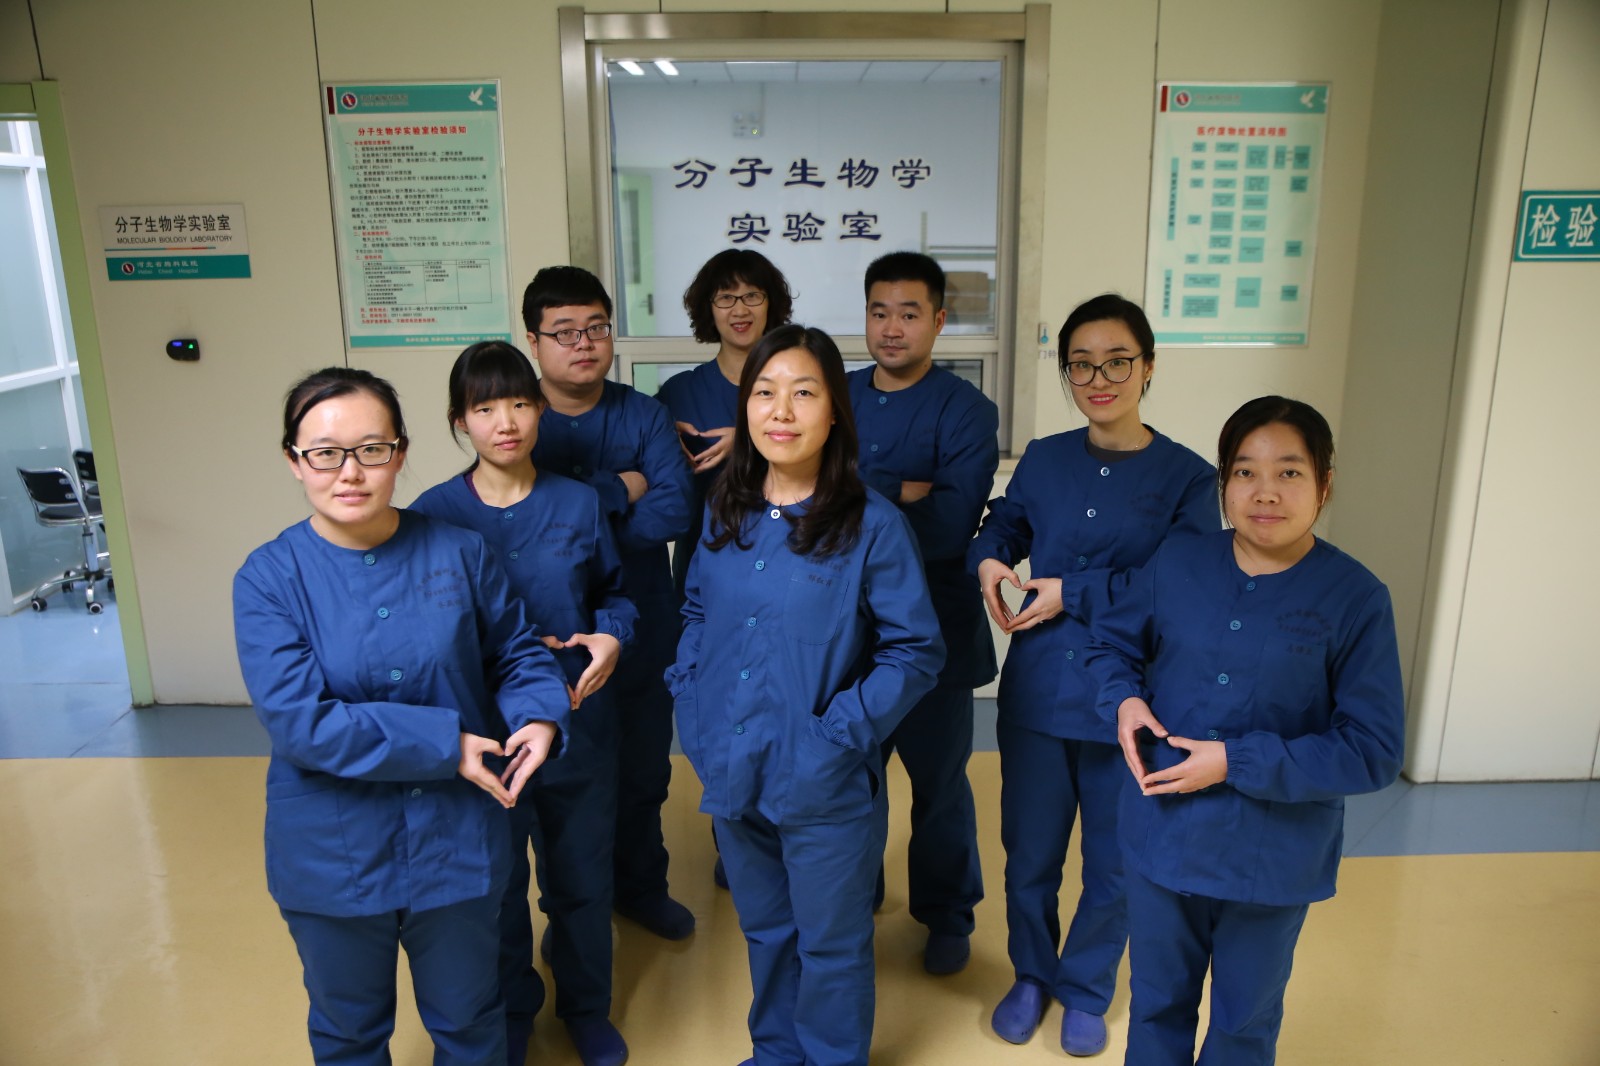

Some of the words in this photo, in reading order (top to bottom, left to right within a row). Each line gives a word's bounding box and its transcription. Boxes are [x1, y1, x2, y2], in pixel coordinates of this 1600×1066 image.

[673, 158, 931, 189] 分子生物学
[115, 214, 231, 233] 分子生物学实验室
[190, 235, 233, 243] LABORATORY
[728, 211, 882, 243] 实验室
[1529, 203, 1598, 249] 检验
